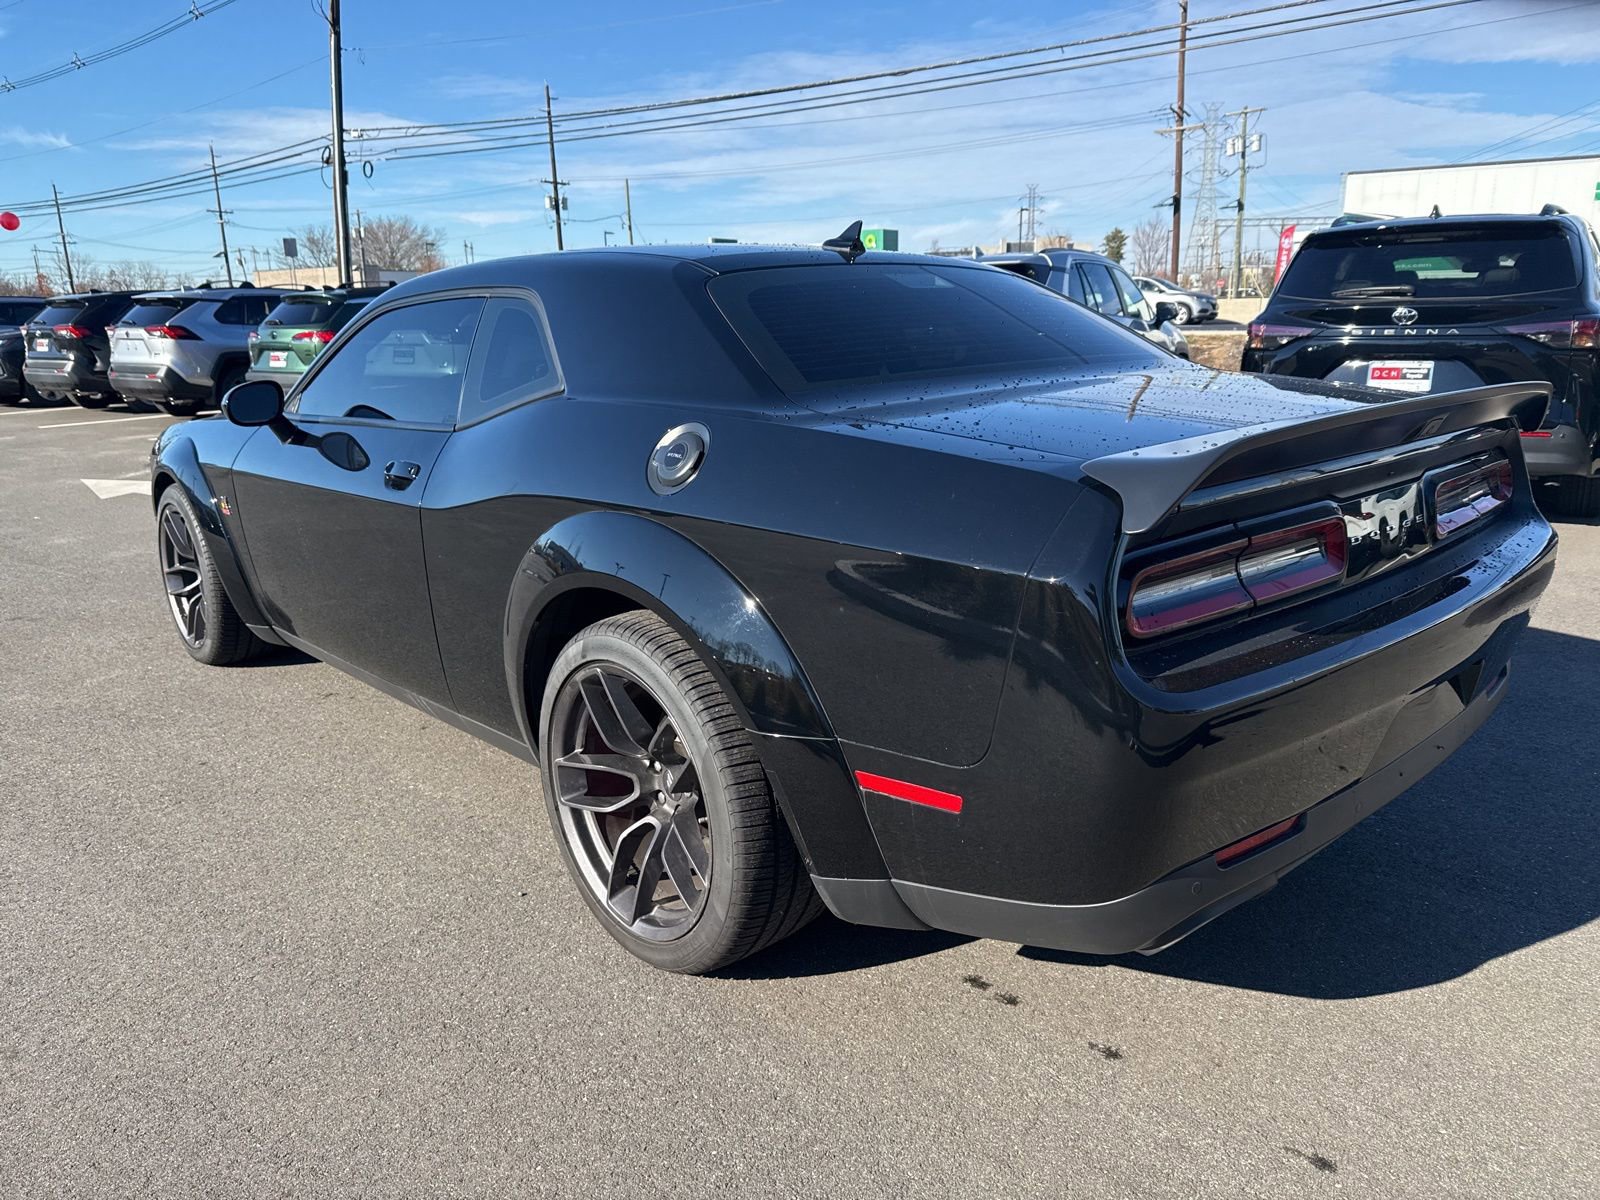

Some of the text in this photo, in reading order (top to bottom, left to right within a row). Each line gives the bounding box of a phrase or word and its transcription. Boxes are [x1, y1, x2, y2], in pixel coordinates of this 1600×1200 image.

[1351, 328, 1460, 336] SIENNA
[1373, 370, 1398, 378] DCH
[1351, 514, 1423, 546] DODGE
